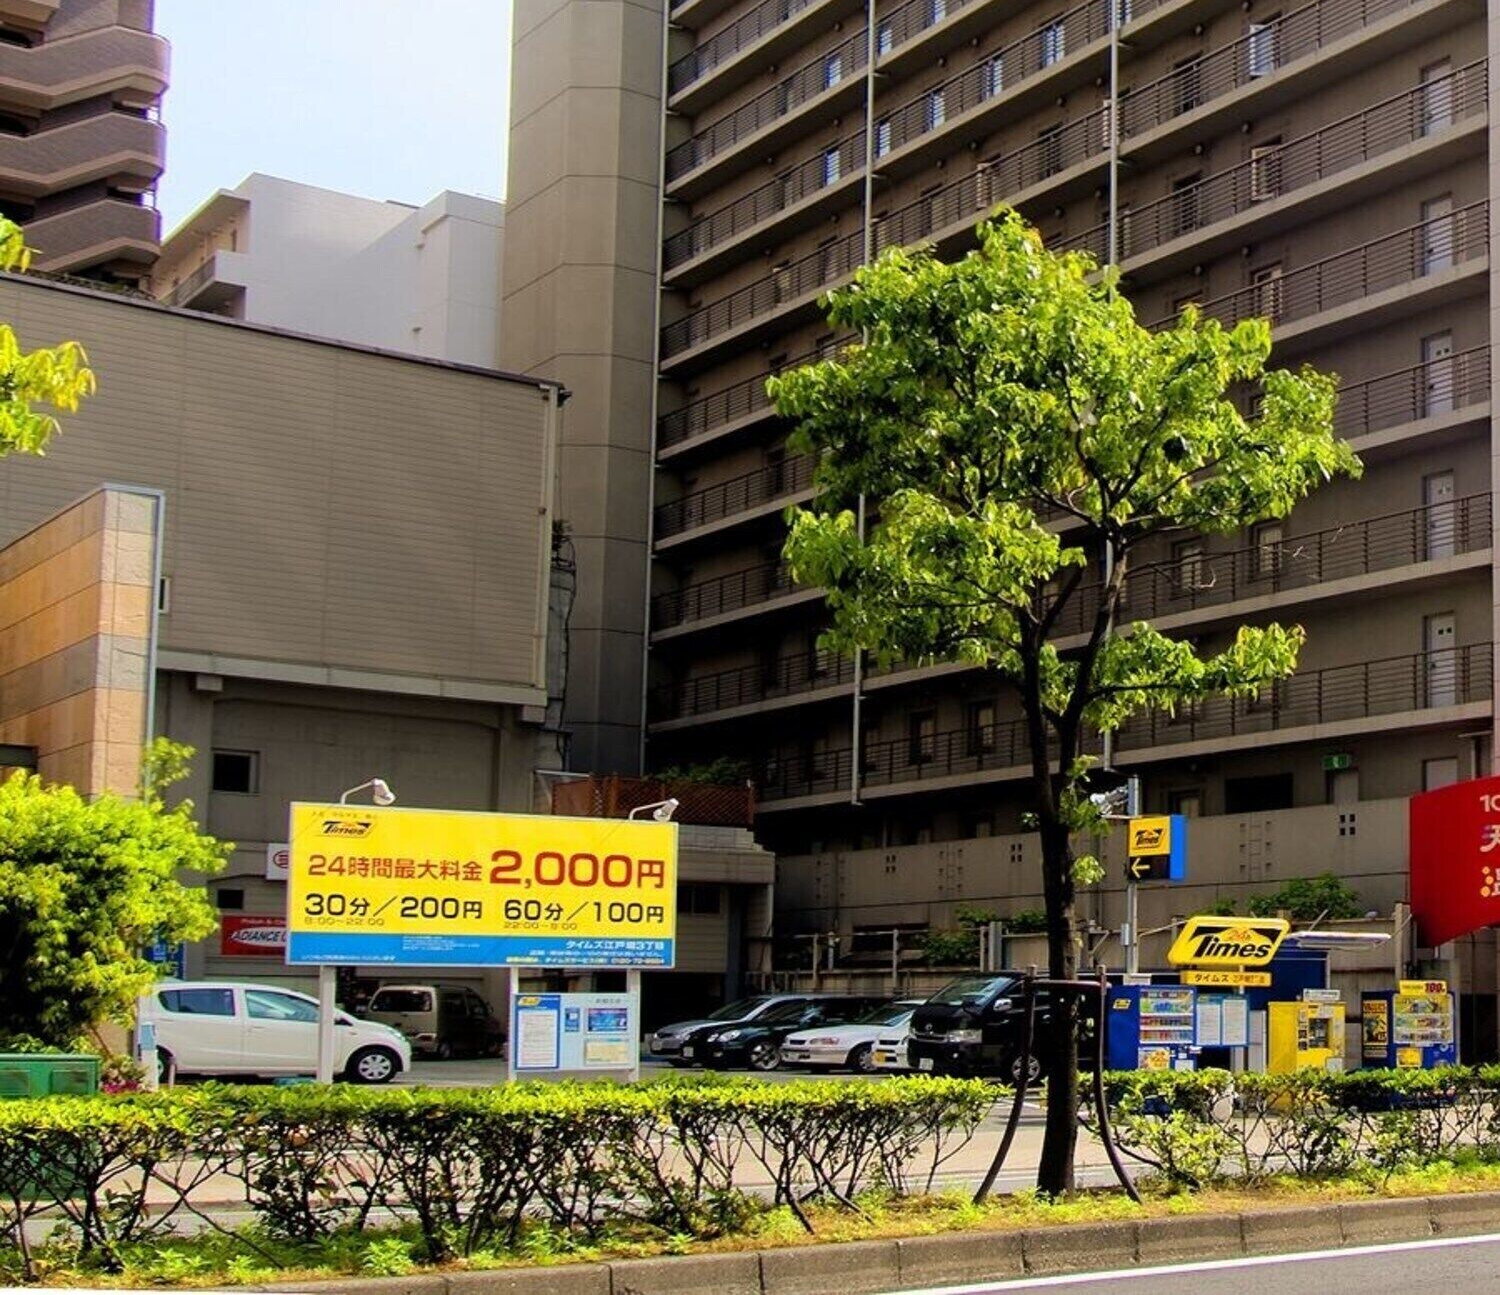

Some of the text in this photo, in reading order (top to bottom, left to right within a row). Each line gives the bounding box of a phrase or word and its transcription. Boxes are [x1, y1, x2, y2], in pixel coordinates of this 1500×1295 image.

[308, 854, 482, 882] 24時間最大料金
[490, 849, 665, 889] 2,000円
[1190, 928, 1279, 958] Times
